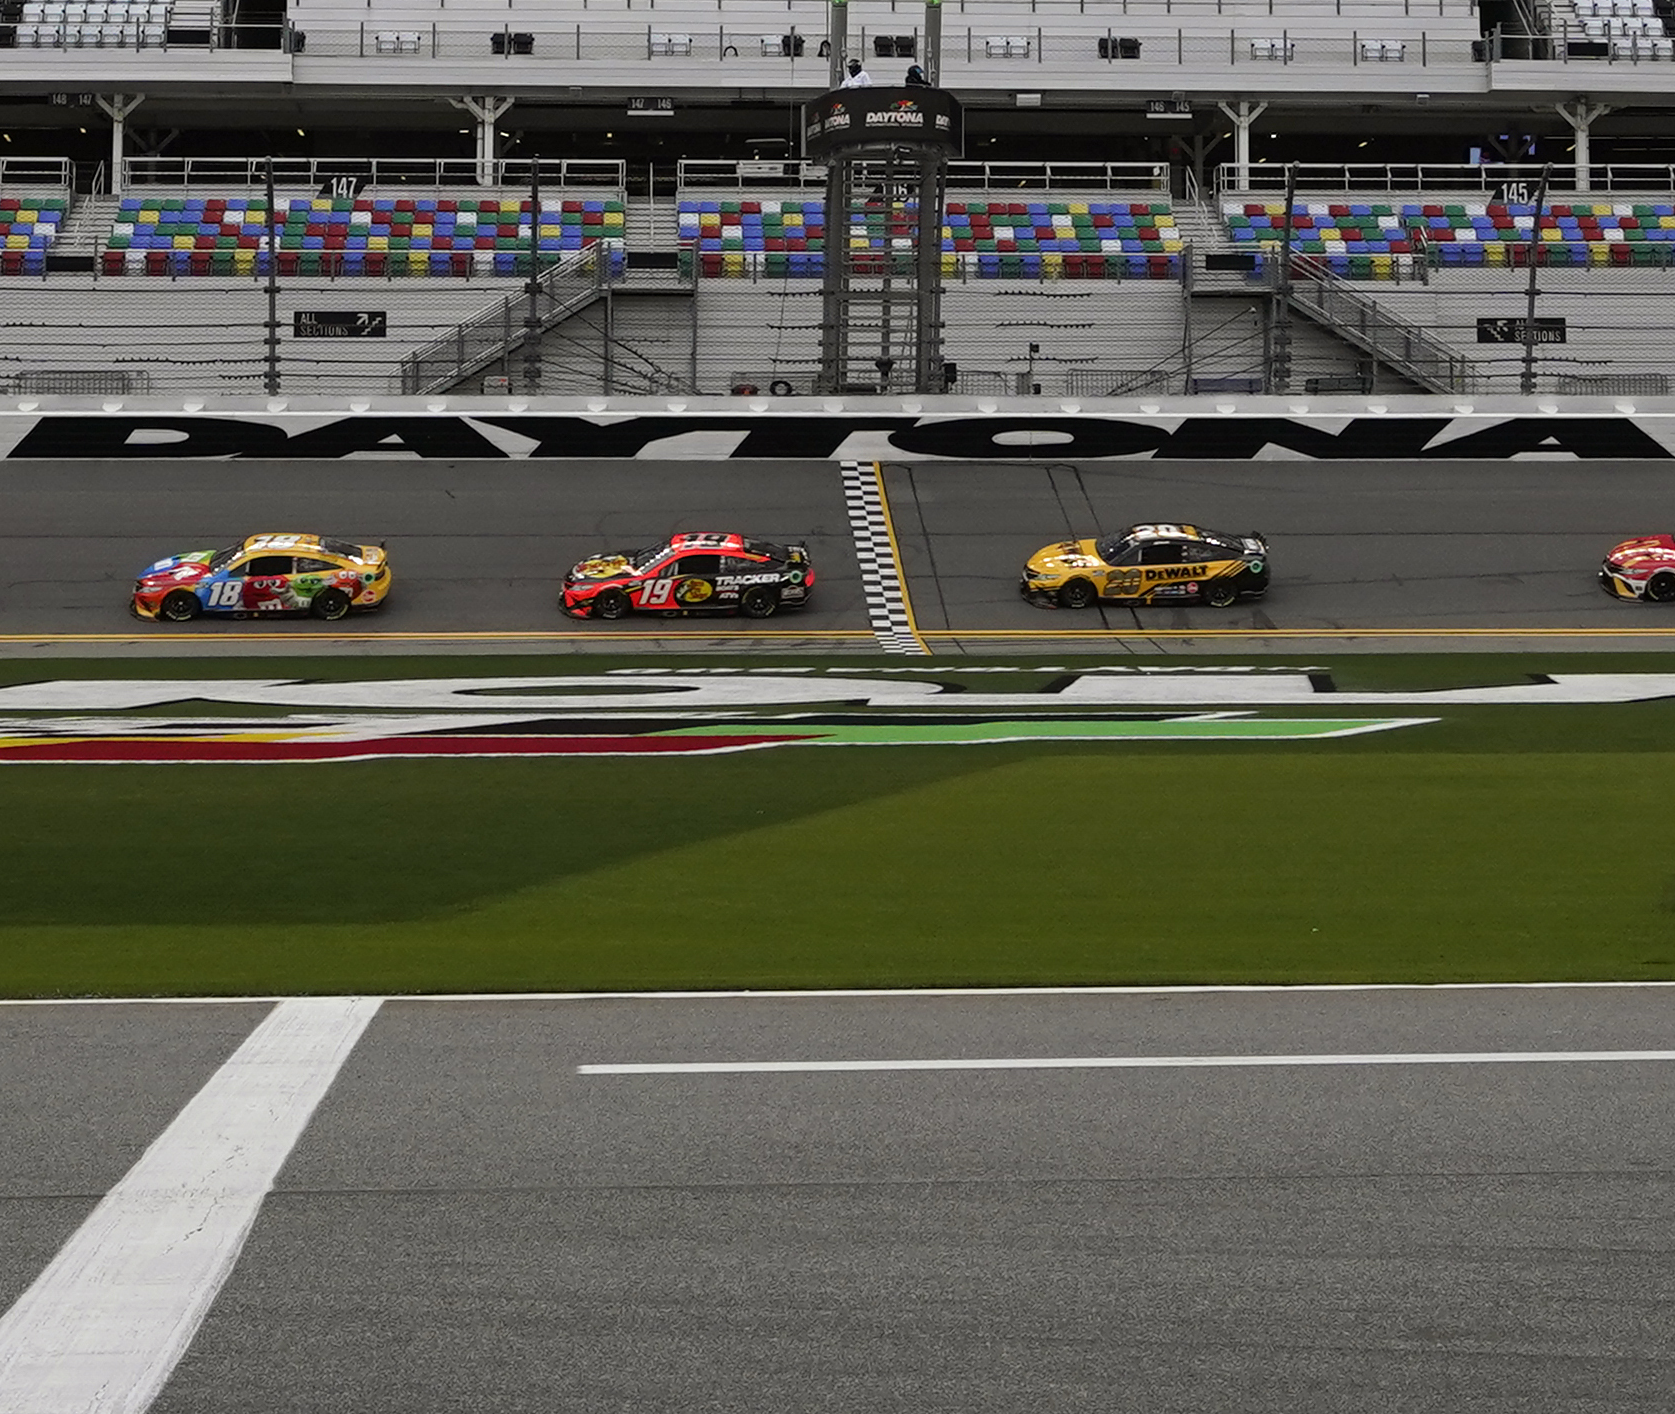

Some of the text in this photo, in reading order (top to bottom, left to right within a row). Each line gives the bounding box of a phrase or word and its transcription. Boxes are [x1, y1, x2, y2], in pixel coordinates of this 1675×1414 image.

[865, 111, 924, 124] DAYTONA
[330, 177, 358, 199] 147
[1501, 182, 1528, 205] 145
[299, 313, 317, 325] ALL
[299, 325, 349, 337] SECTIONS
[1514, 329, 1561, 342] SETIONS
[6, 417, 1675, 459] DAYTONA
[714, 573, 781, 586] TRACKER
[208, 581, 243, 607] 18
[639, 578, 674, 605] 19
